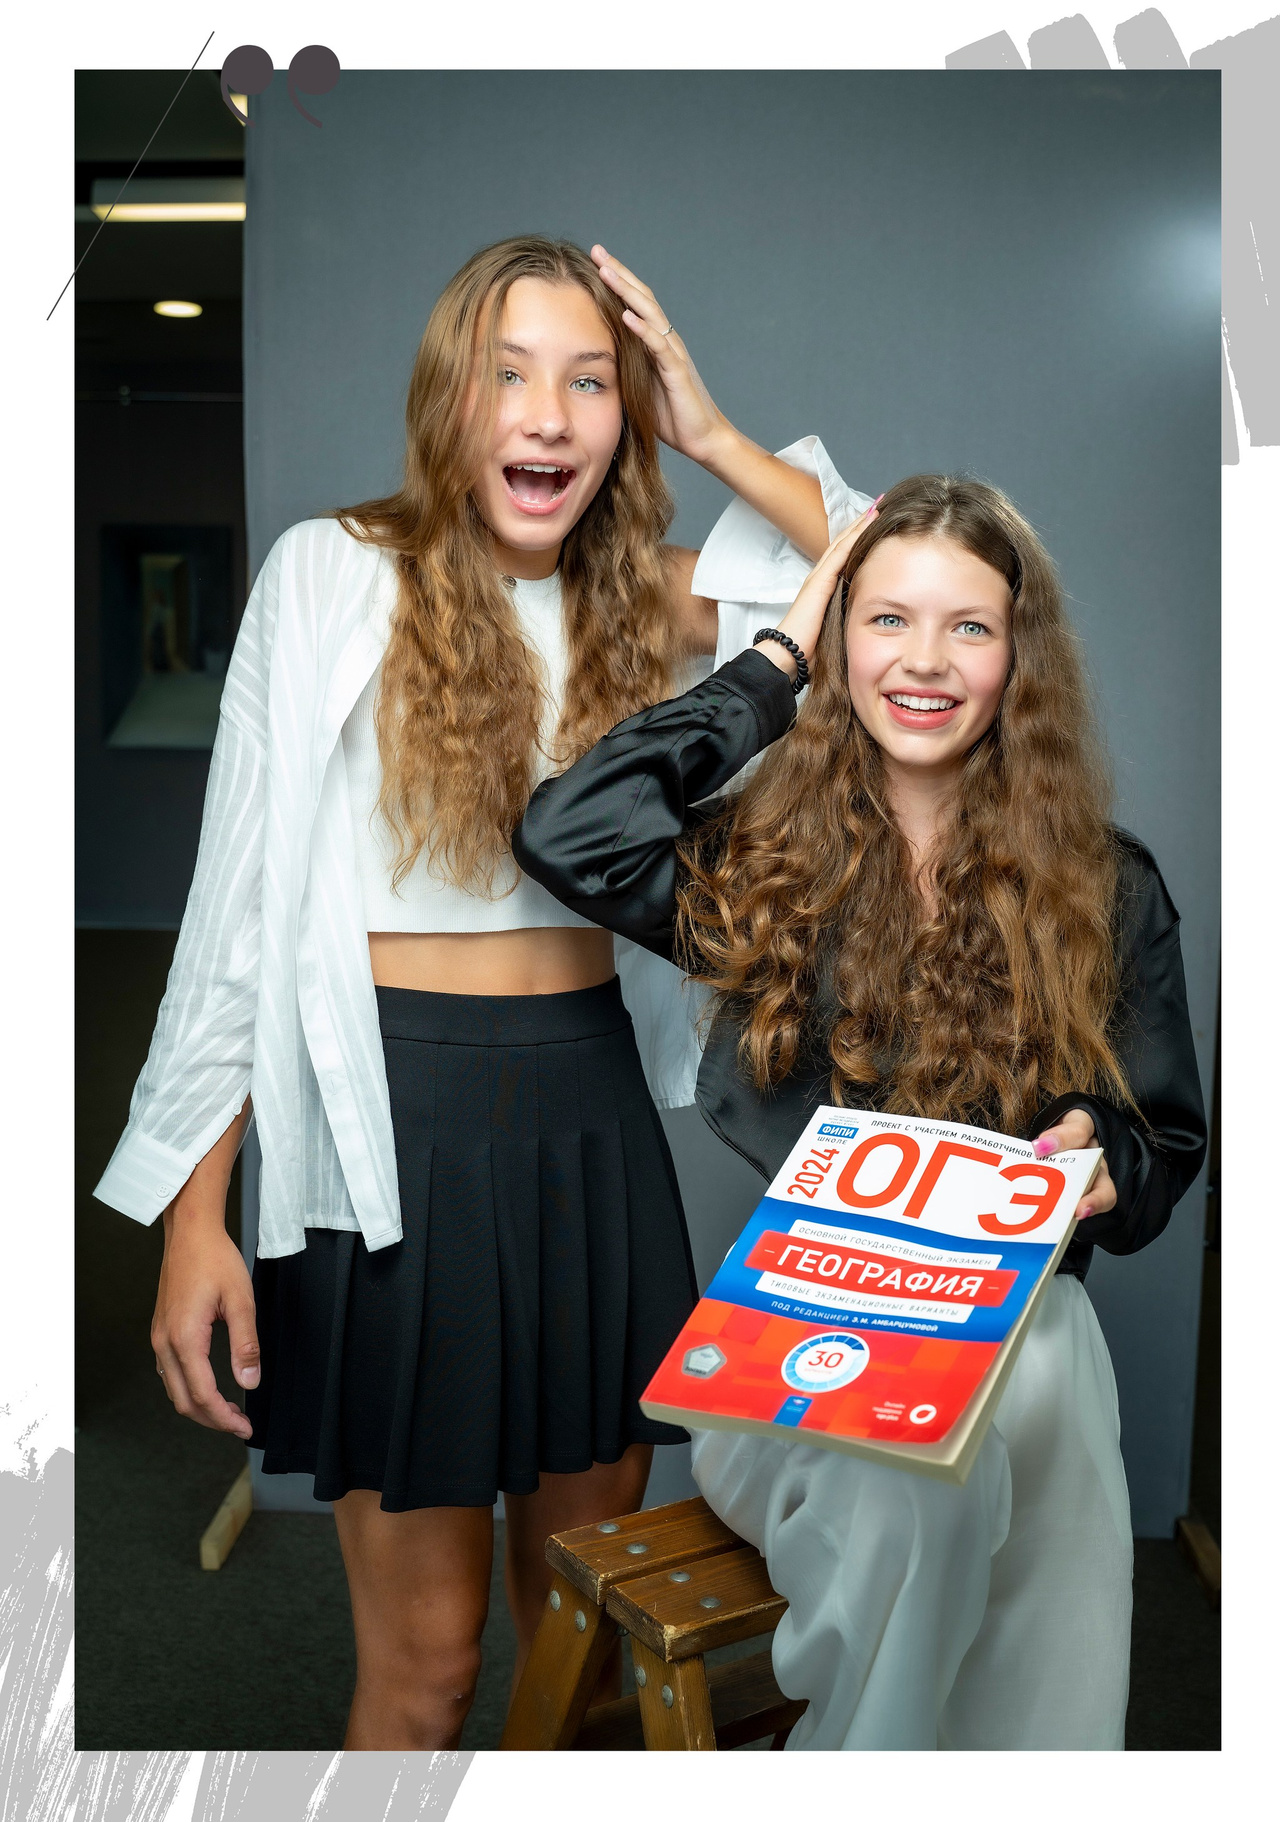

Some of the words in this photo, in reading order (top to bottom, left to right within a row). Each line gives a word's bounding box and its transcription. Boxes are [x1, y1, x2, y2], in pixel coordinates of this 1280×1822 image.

[817, 1136, 847, 1145] ШКОЛЕ
[822, 1125, 855, 1137] ФИПИ
[871, 1120, 902, 1130] ПРОЕКТ
[914, 1126, 958, 1138] УЧАСТИЕМ
[961, 1133, 1033, 1158] РАЗРАБОТЧИКОВ
[787, 1148, 840, 1199] 2024
[836, 1133, 1066, 1235] ОГЭ
[798, 1227, 847, 1242] ОСНОВНОЙ
[850, 1236, 943, 1262] ГОСУДАРСТВЕННЫЙ
[946, 1256, 992, 1265] ЭКЗАМЕН
[777, 1245, 984, 1297] ГЕОГРАФИЯ
[770, 1280, 811, 1295] ТИПОВЫЕ
[815, 1291, 904, 1311] ЭКЗАМЕНАЦИОННЫЕ
[909, 1304, 959, 1316] ВАРИАНТЫ
[771, 1300, 791, 1312] ПОД
[793, 1306, 849, 1322] РЕДАКЦИЕЙ
[871, 1319, 938, 1332] АМБАРЦУМОВОЙ
[808, 1350, 844, 1368] 30
